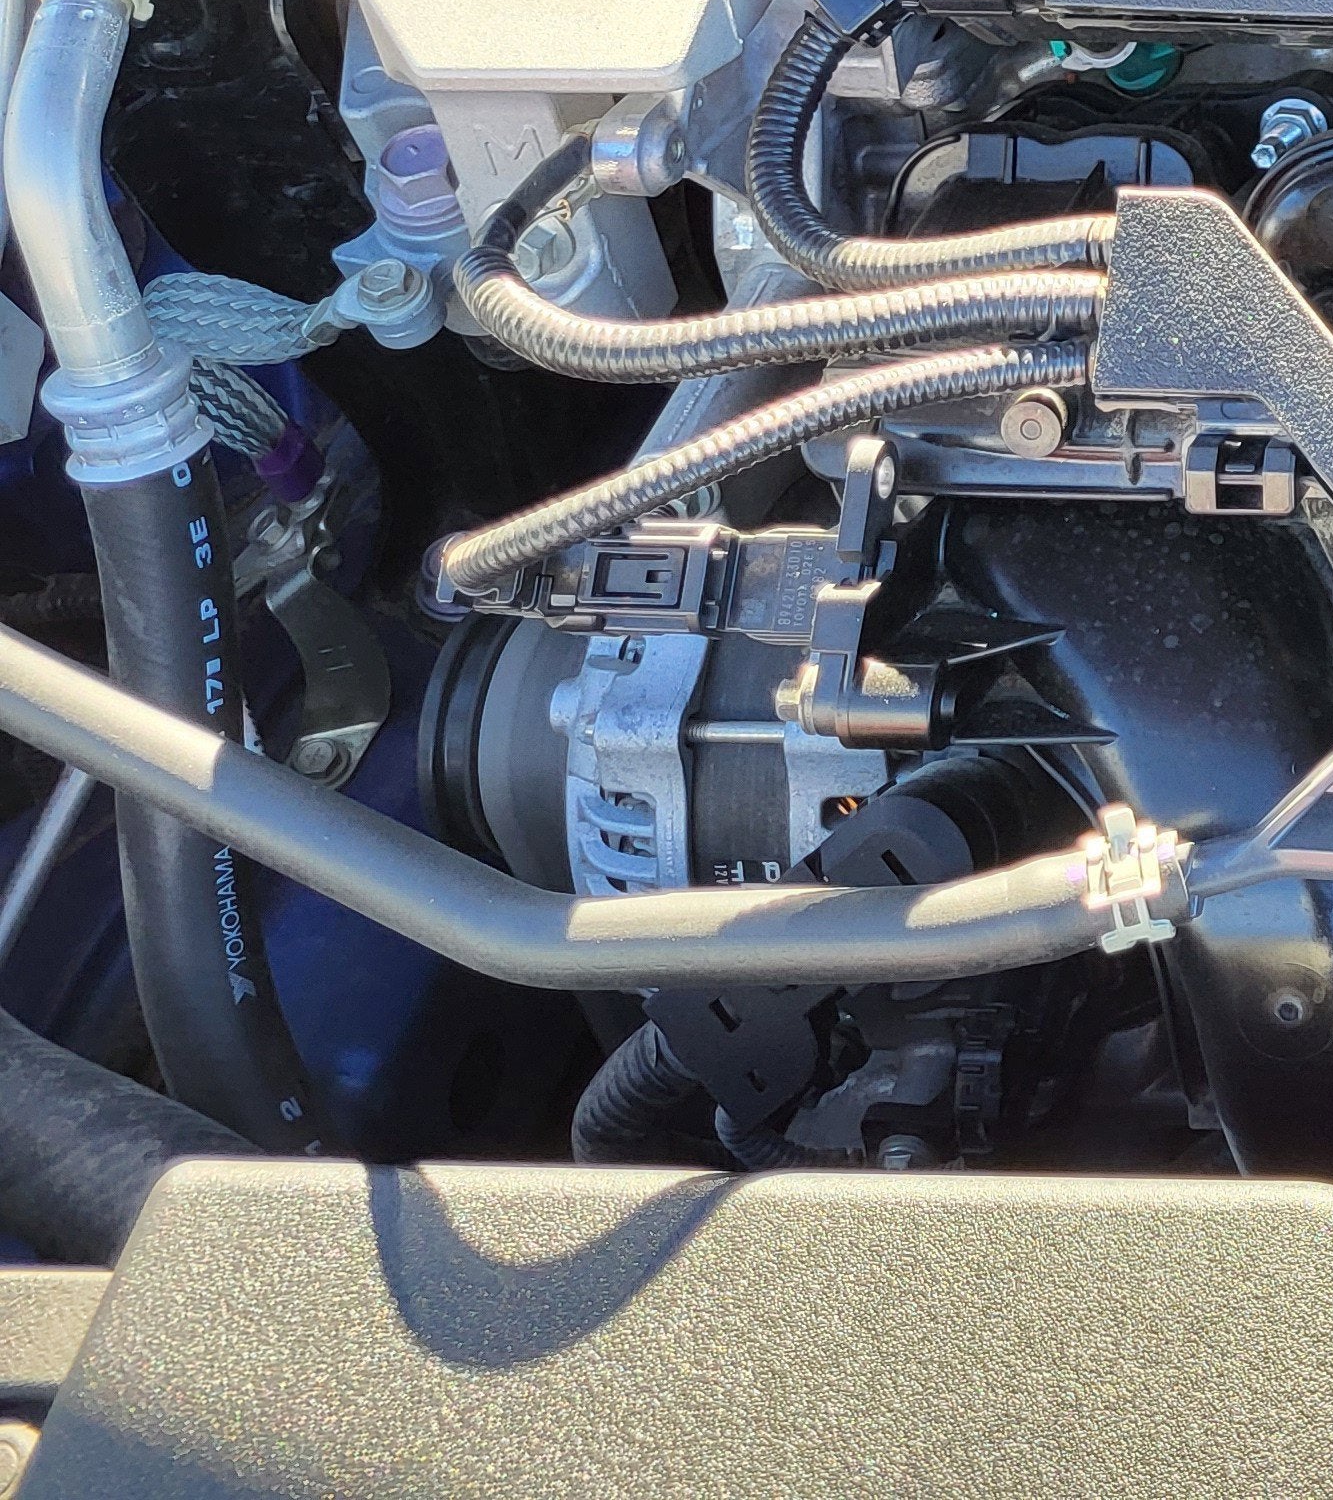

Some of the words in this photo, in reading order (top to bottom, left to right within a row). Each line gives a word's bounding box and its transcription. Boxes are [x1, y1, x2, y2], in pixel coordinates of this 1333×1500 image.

[199, 597, 222, 644] LP
[793, 583, 808, 627] TOYOTA
[213, 844, 247, 971] YOKOHAMA
